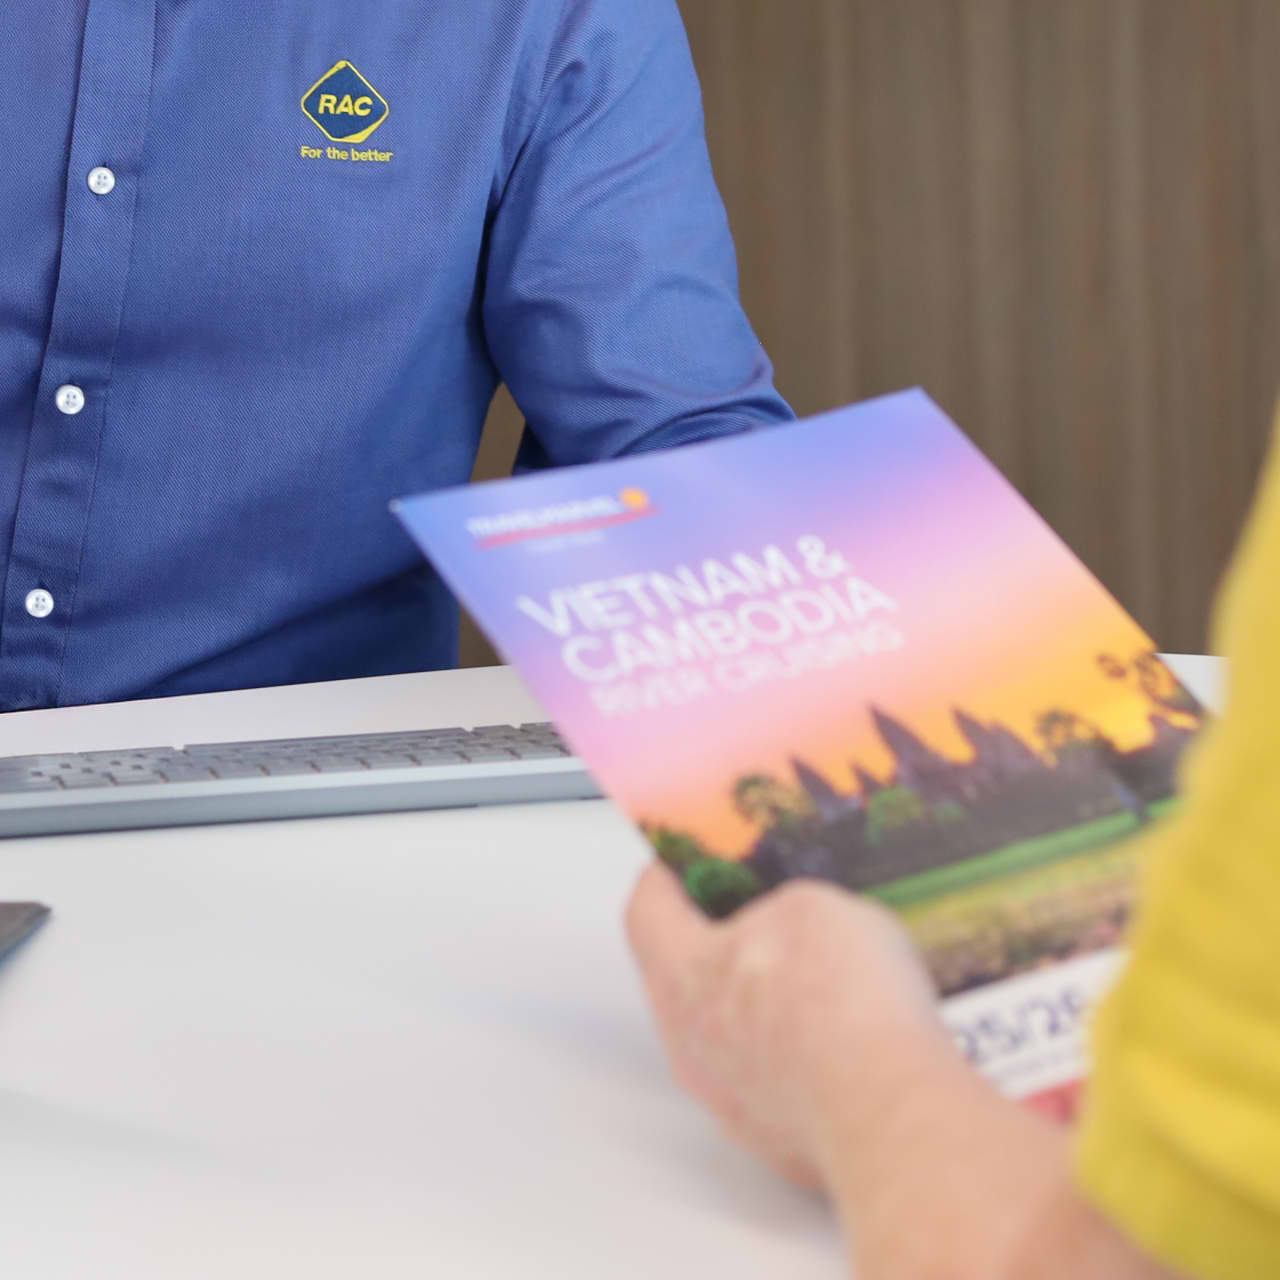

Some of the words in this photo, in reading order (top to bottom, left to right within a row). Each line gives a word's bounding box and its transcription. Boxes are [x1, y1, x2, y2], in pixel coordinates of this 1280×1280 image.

[300, 145, 323, 160] For
[325, 146, 348, 161] the
[351, 147, 394, 163] better
[318, 94, 373, 116] RAC
[516, 543, 803, 638] VIETNAM
[795, 534, 855, 581] &
[561, 575, 900, 683] CAMBODIA
[589, 666, 710, 718] RIVER
[712, 619, 905, 692] CRUISING
